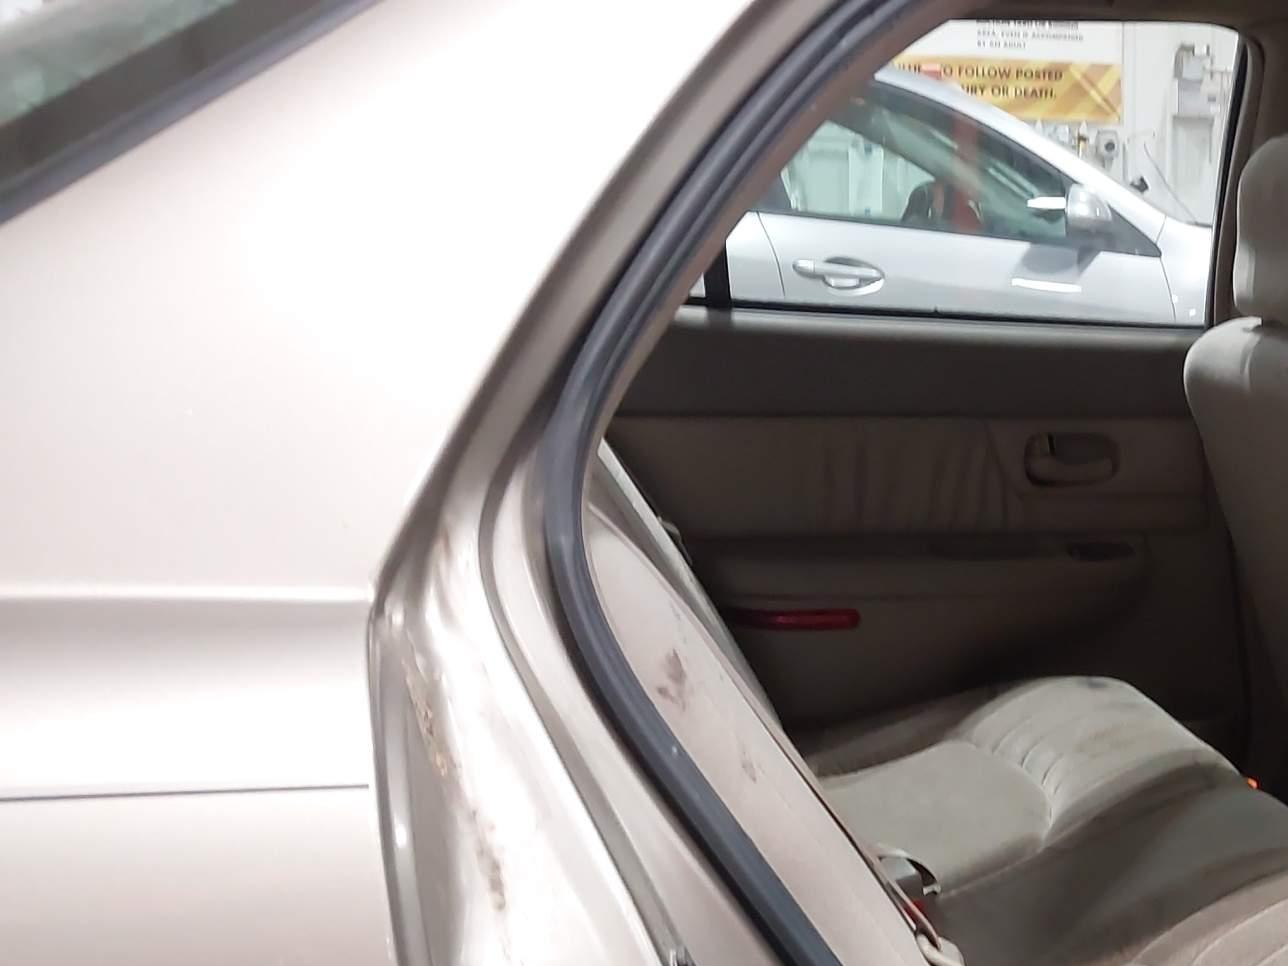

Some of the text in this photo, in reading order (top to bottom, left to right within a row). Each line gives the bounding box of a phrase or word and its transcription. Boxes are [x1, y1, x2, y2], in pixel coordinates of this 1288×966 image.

[958, 65, 1011, 79] FOLLOW
[1016, 67, 1063, 81] POSTED
[991, 85, 1009, 97] OR
